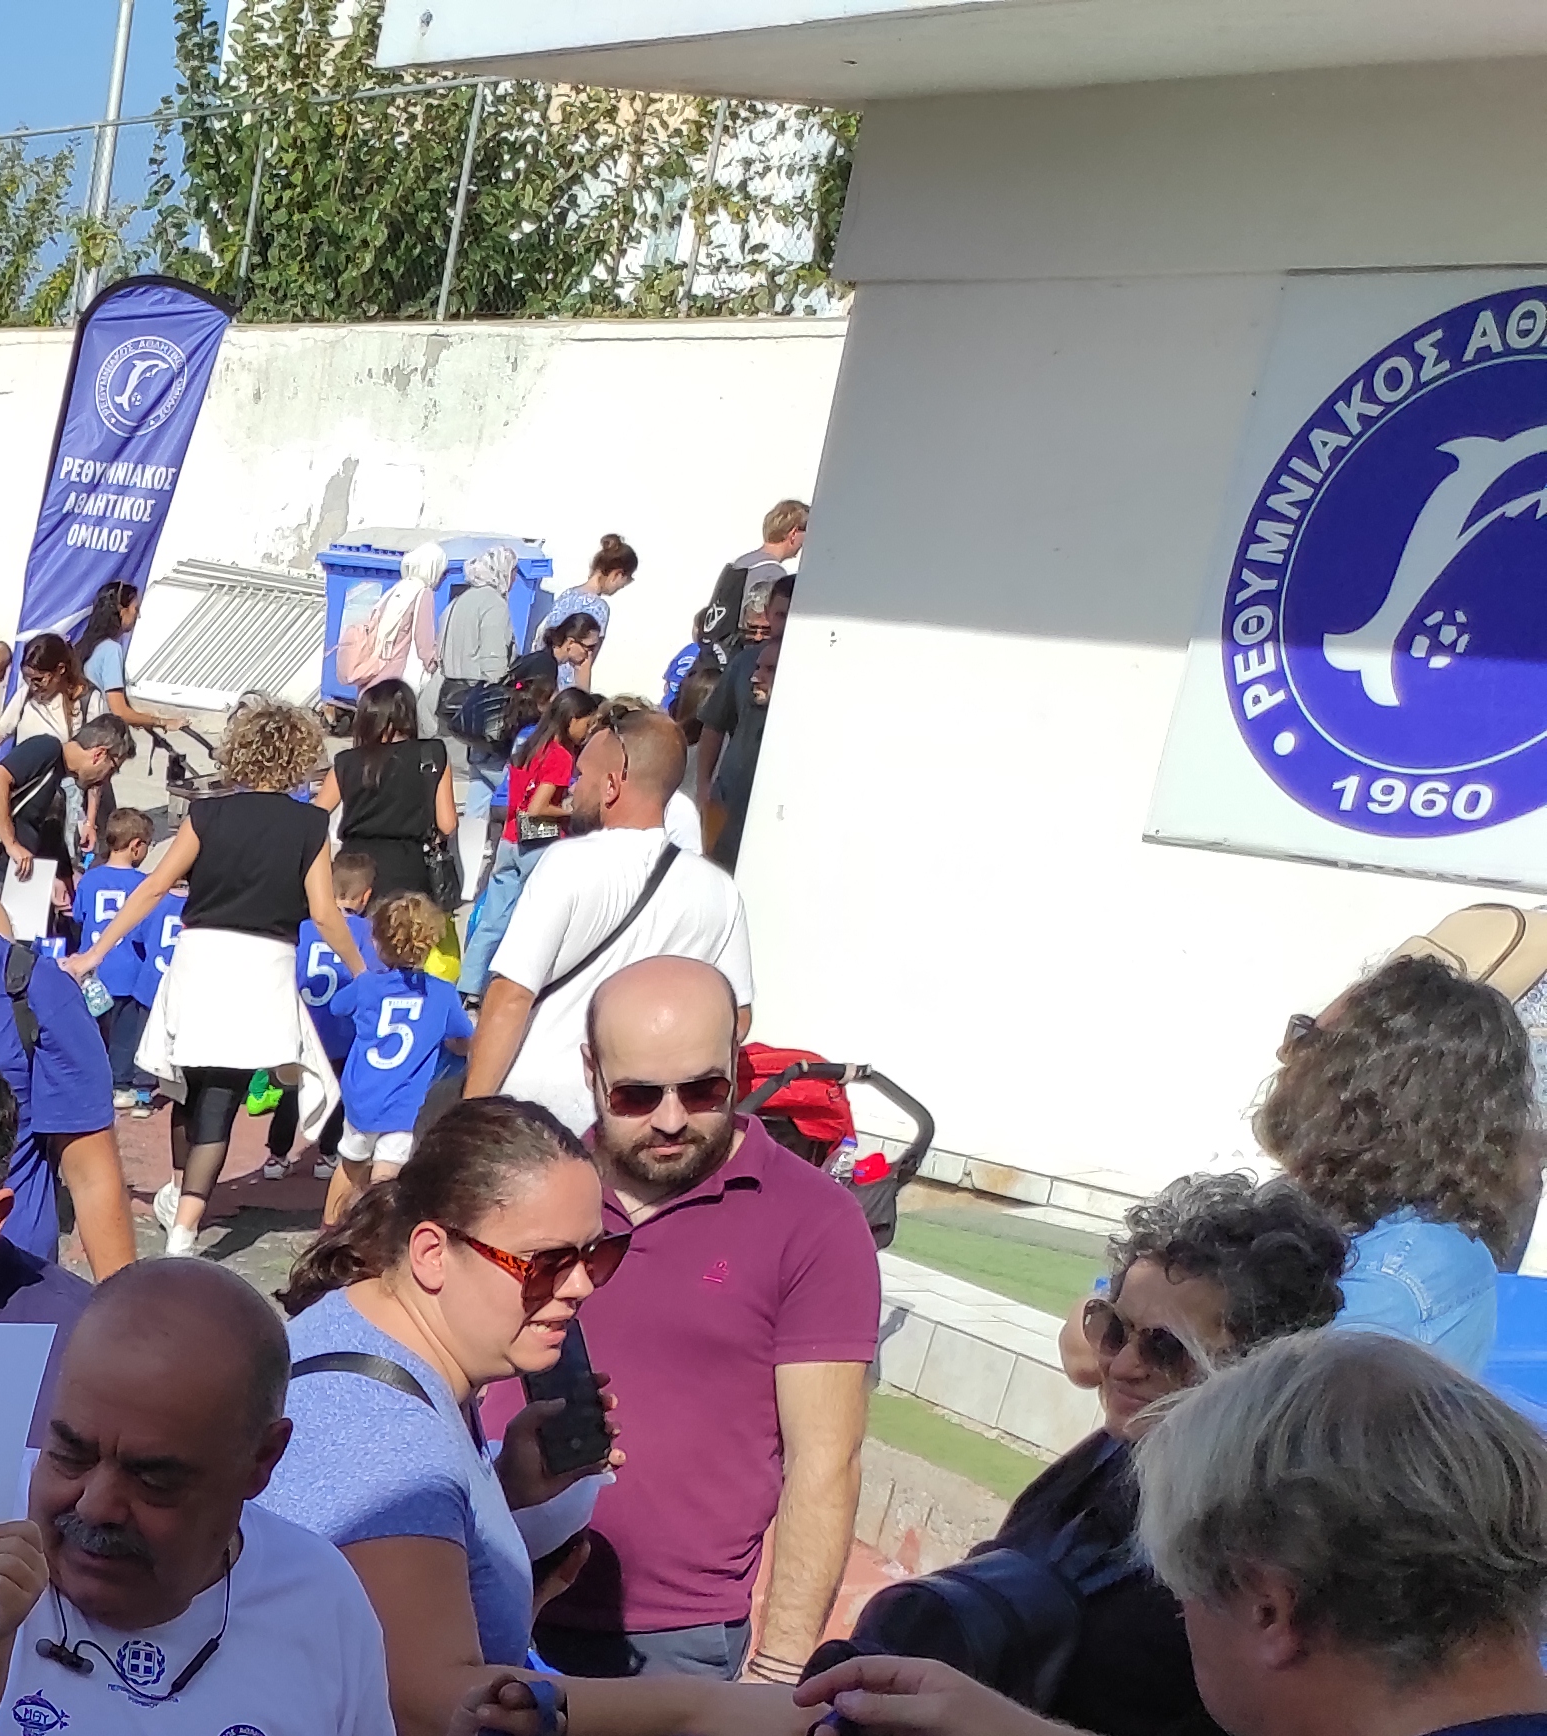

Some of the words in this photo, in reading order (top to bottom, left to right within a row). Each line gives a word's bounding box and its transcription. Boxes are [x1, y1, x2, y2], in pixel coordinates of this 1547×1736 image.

[59, 455, 177, 491] ΡΕΘΥΜΝΙΑΚΟΣ
[62, 491, 157, 523] ΑΘΛΗΤΙΚΟΣ
[1228, 328, 1453, 721] ΡΕΘΥΜΝΙΑΚΟΣ
[67, 523, 134, 554] ΟΜΙΛΟΣ
[1331, 774, 1495, 824] 1960
[301, 941, 343, 1007] 5
[366, 996, 424, 1070] 5
